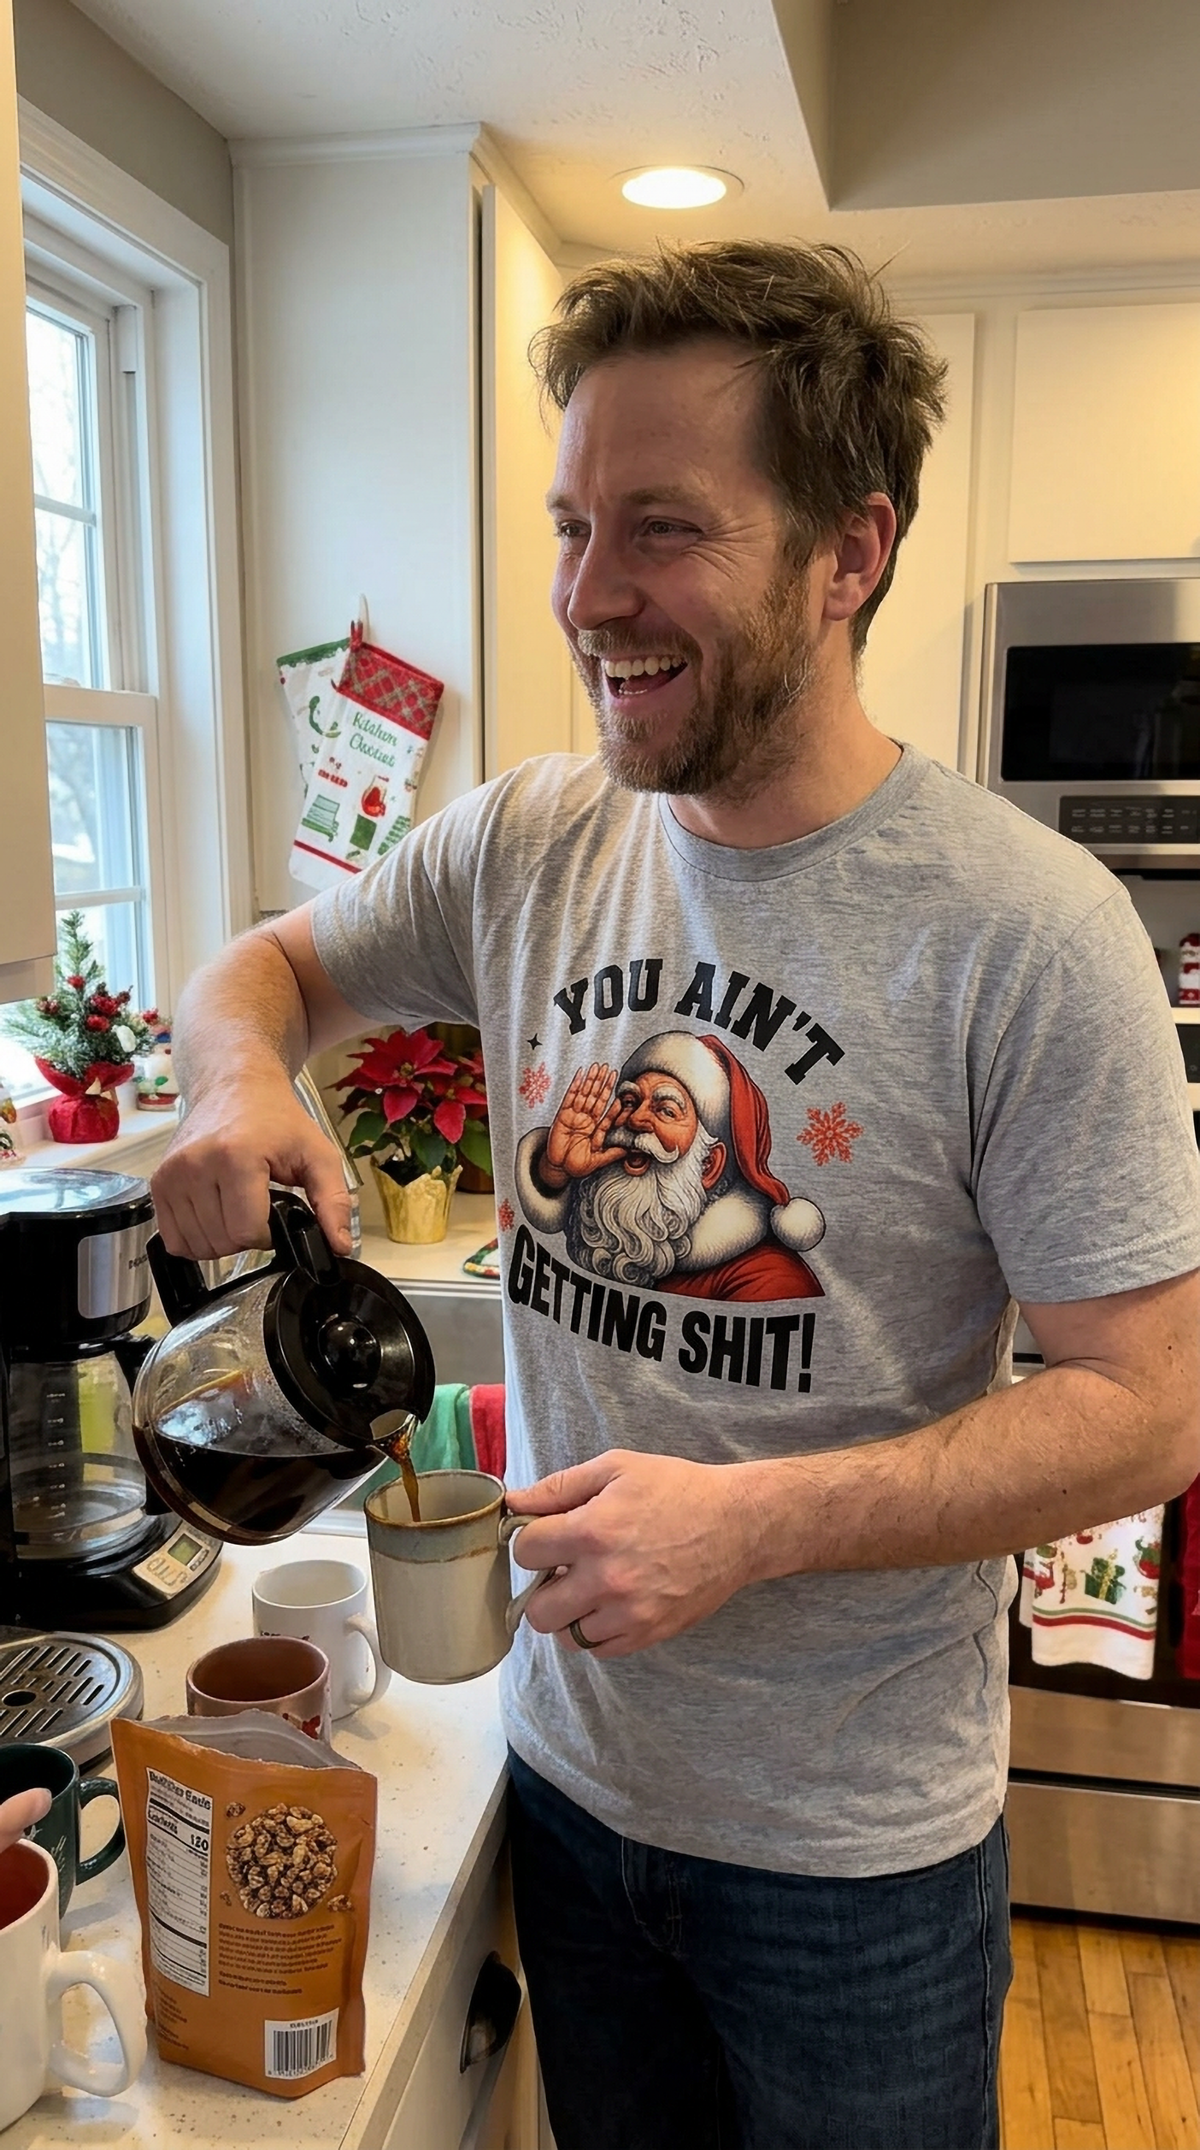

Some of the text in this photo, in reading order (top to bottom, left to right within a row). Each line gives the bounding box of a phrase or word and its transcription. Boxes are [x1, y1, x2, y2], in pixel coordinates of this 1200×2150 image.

[553, 958, 846, 1086] YOU AIN'T
[507, 1223, 816, 1394] GETTING SHIT!
[190, 1833, 209, 1852] 120
